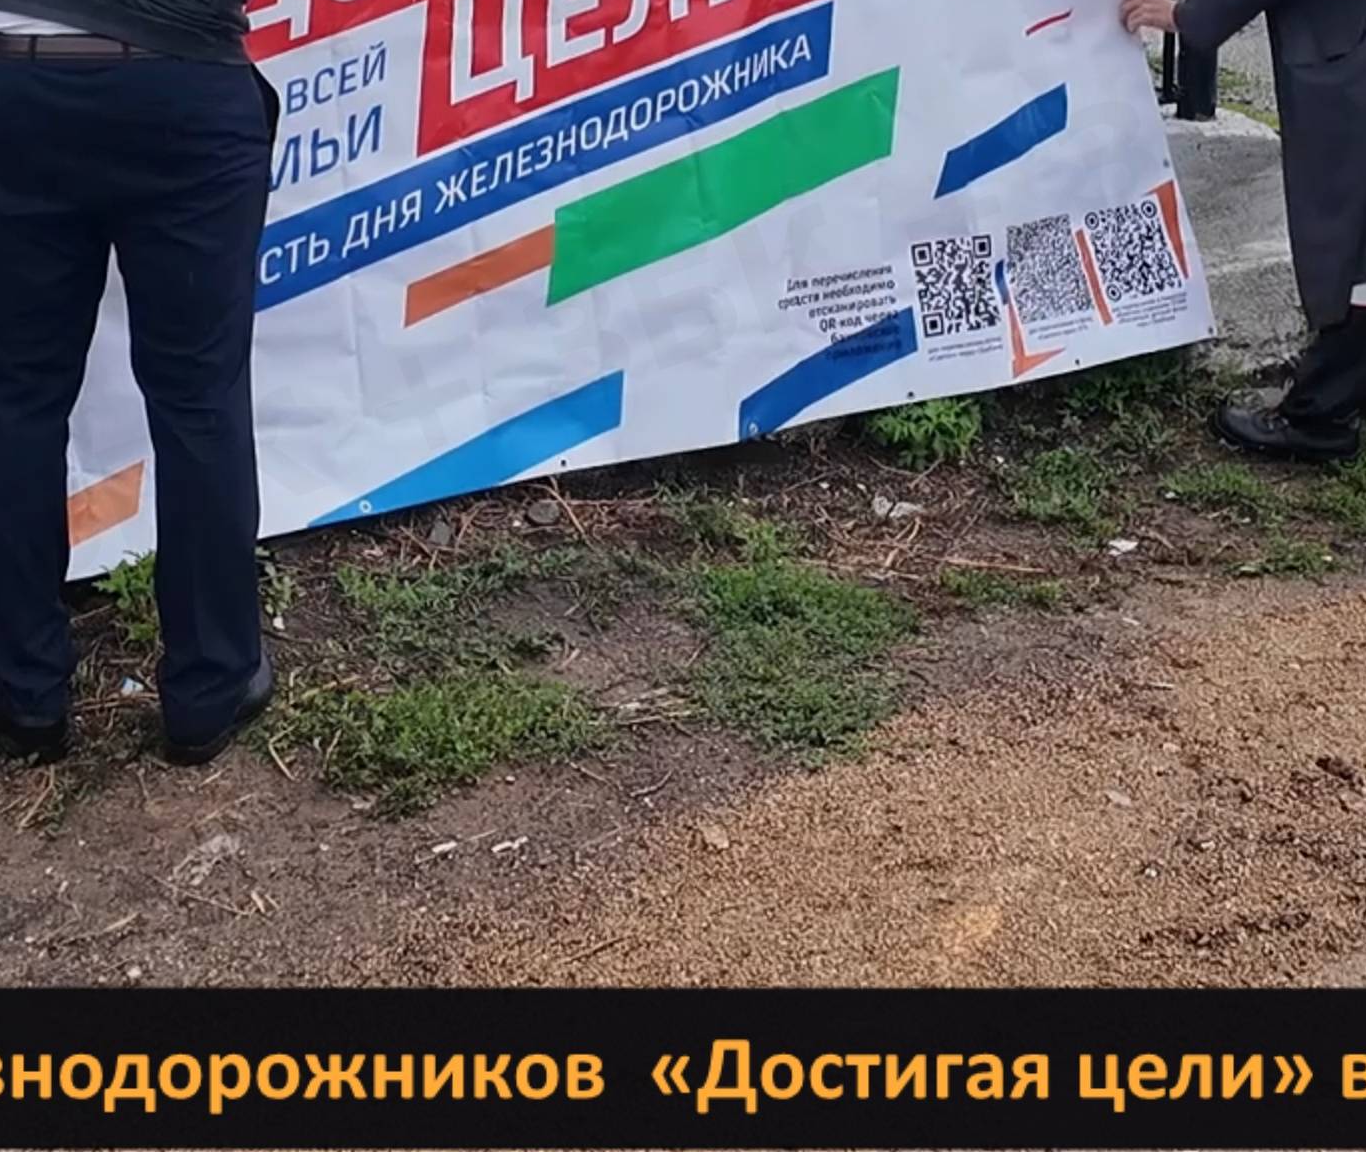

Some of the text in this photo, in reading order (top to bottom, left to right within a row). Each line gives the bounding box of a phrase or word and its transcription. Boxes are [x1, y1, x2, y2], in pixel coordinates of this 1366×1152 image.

[285, 41, 388, 116] ВСЕЙ
[341, 189, 423, 259] ДНЯ
[435, 34, 812, 215] ЖЕЛЕЗНОДОРОЖНИКА
